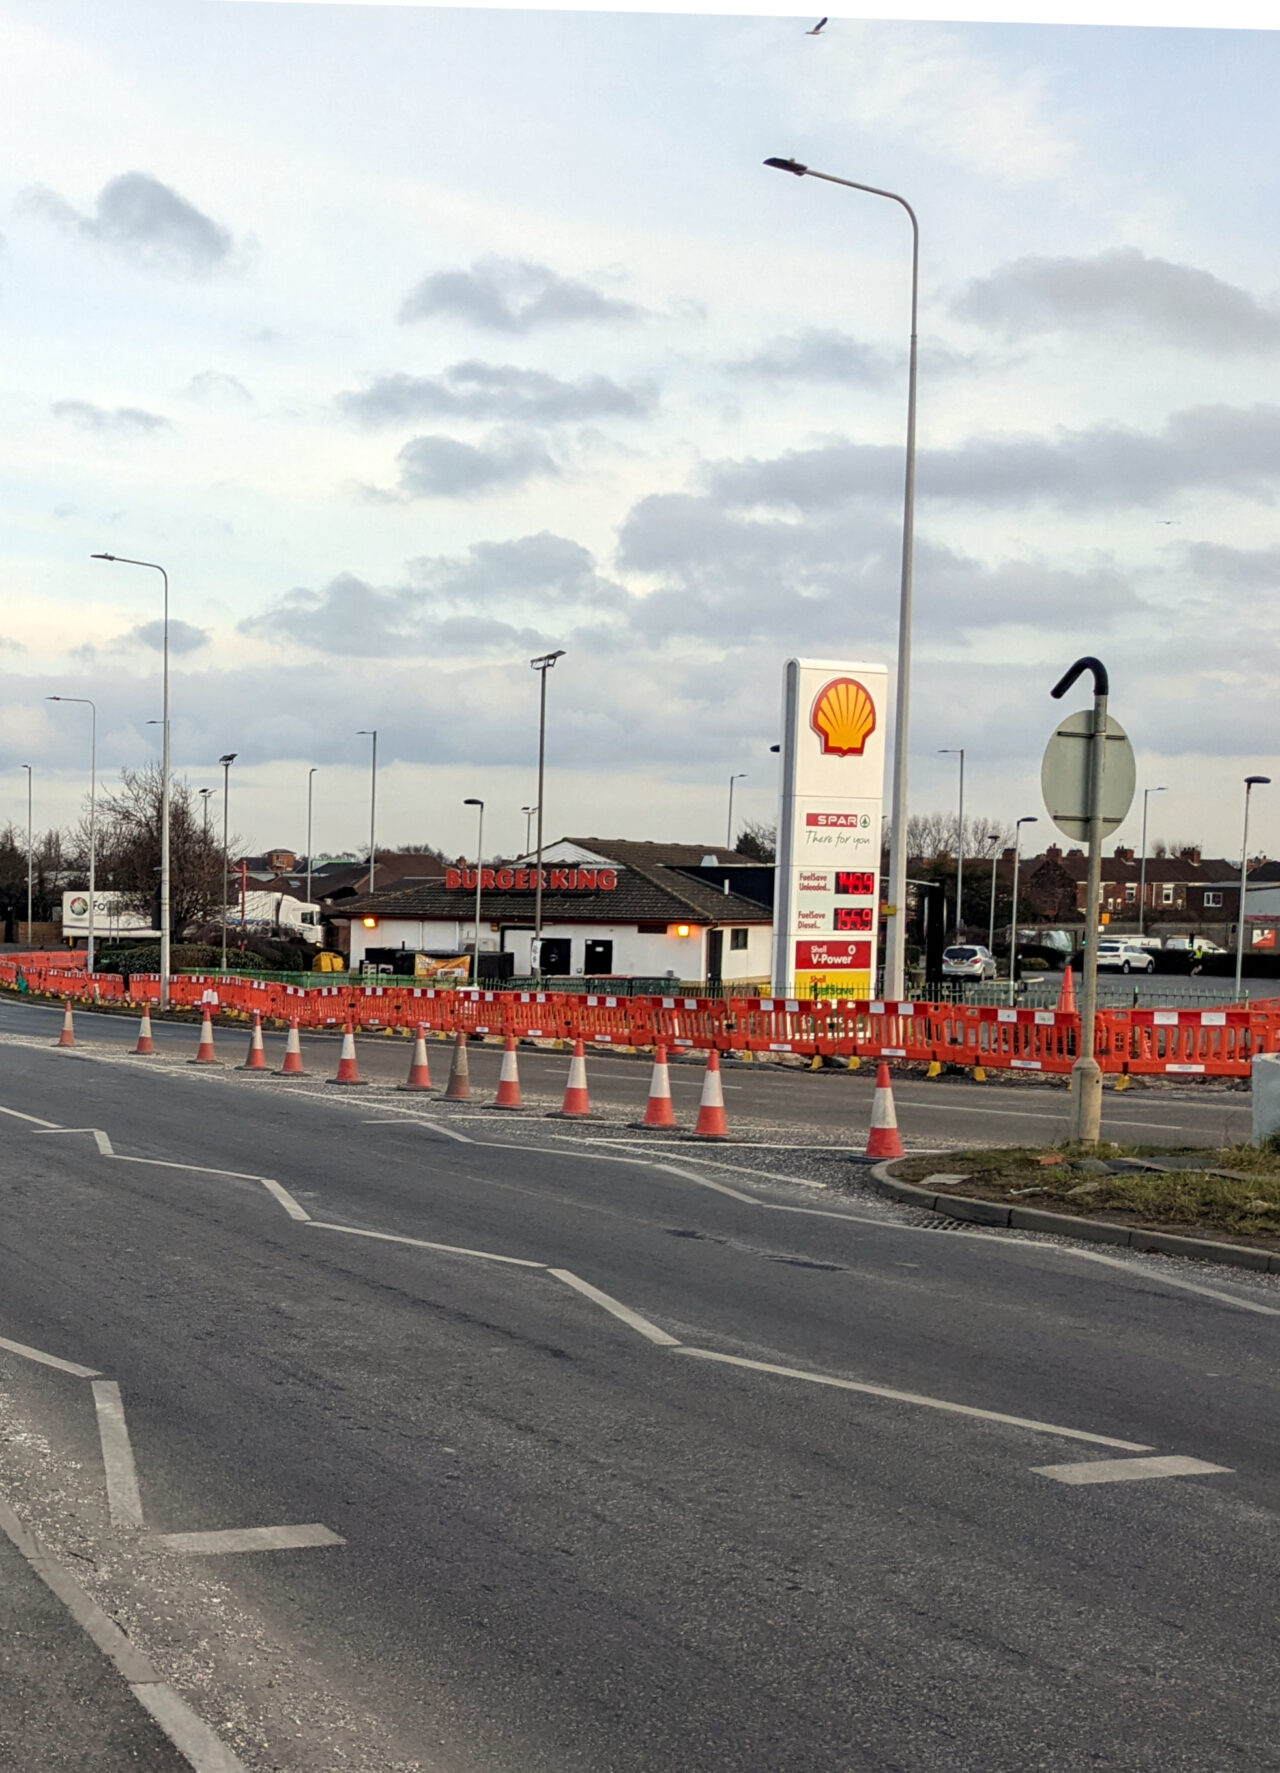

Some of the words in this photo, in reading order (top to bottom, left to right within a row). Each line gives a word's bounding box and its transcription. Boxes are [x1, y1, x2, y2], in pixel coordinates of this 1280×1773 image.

[817, 815, 857, 826] SPAR
[805, 830, 833, 844] There
[834, 831, 851, 848] for
[853, 837, 870, 851] you
[445, 868, 547, 890] BURGER
[550, 868, 618, 891] KING
[811, 945, 827, 953] Shell
[811, 954, 853, 964] V-Power
